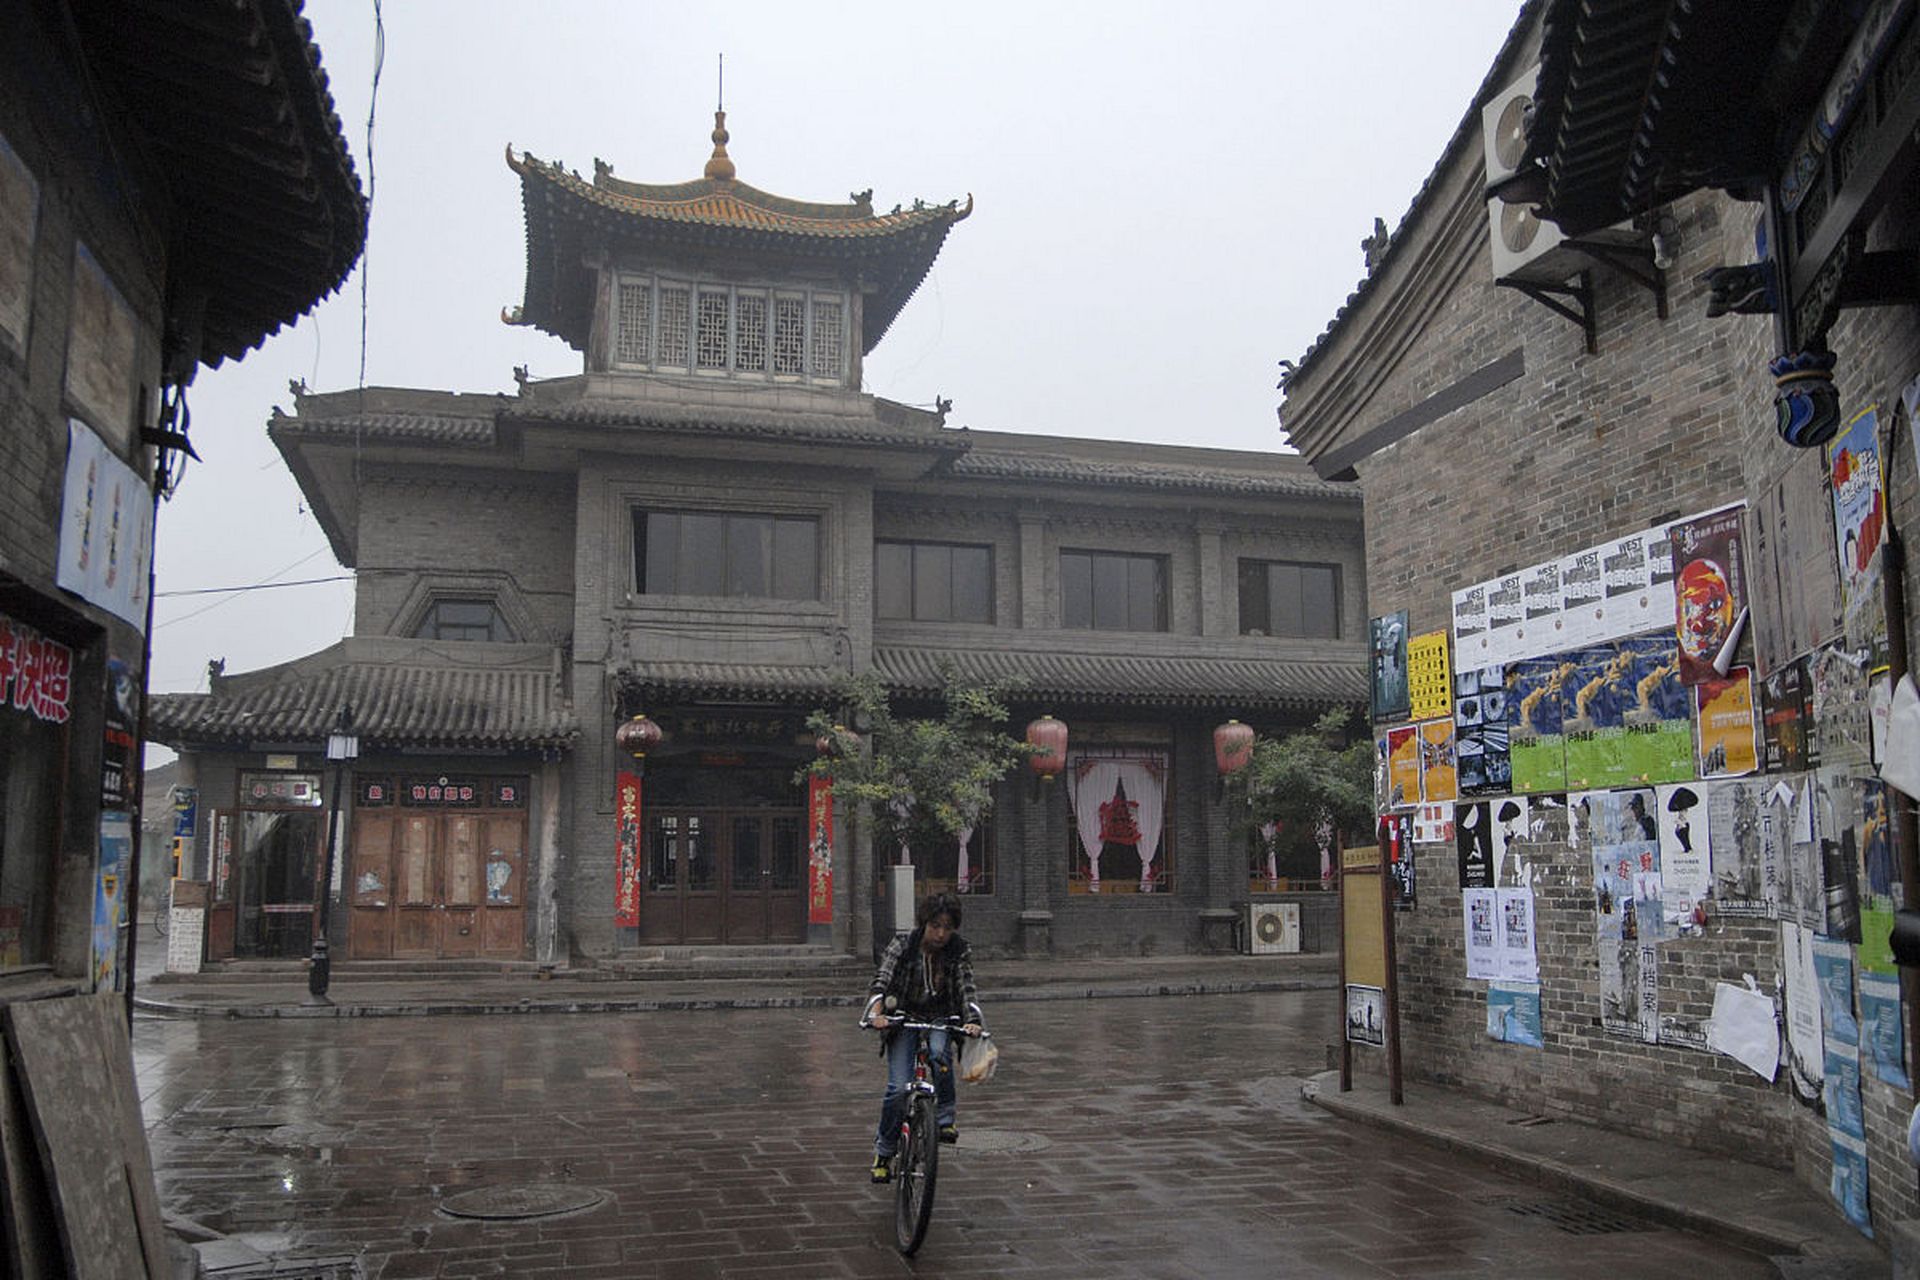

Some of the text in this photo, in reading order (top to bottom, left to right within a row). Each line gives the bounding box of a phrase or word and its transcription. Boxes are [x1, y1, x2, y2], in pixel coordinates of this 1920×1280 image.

[1619, 537, 1644, 553] WEST
[1576, 551, 1599, 567] WEST
[1500, 576, 1520, 589] WEST
[1465, 587, 1485, 600] WEST
